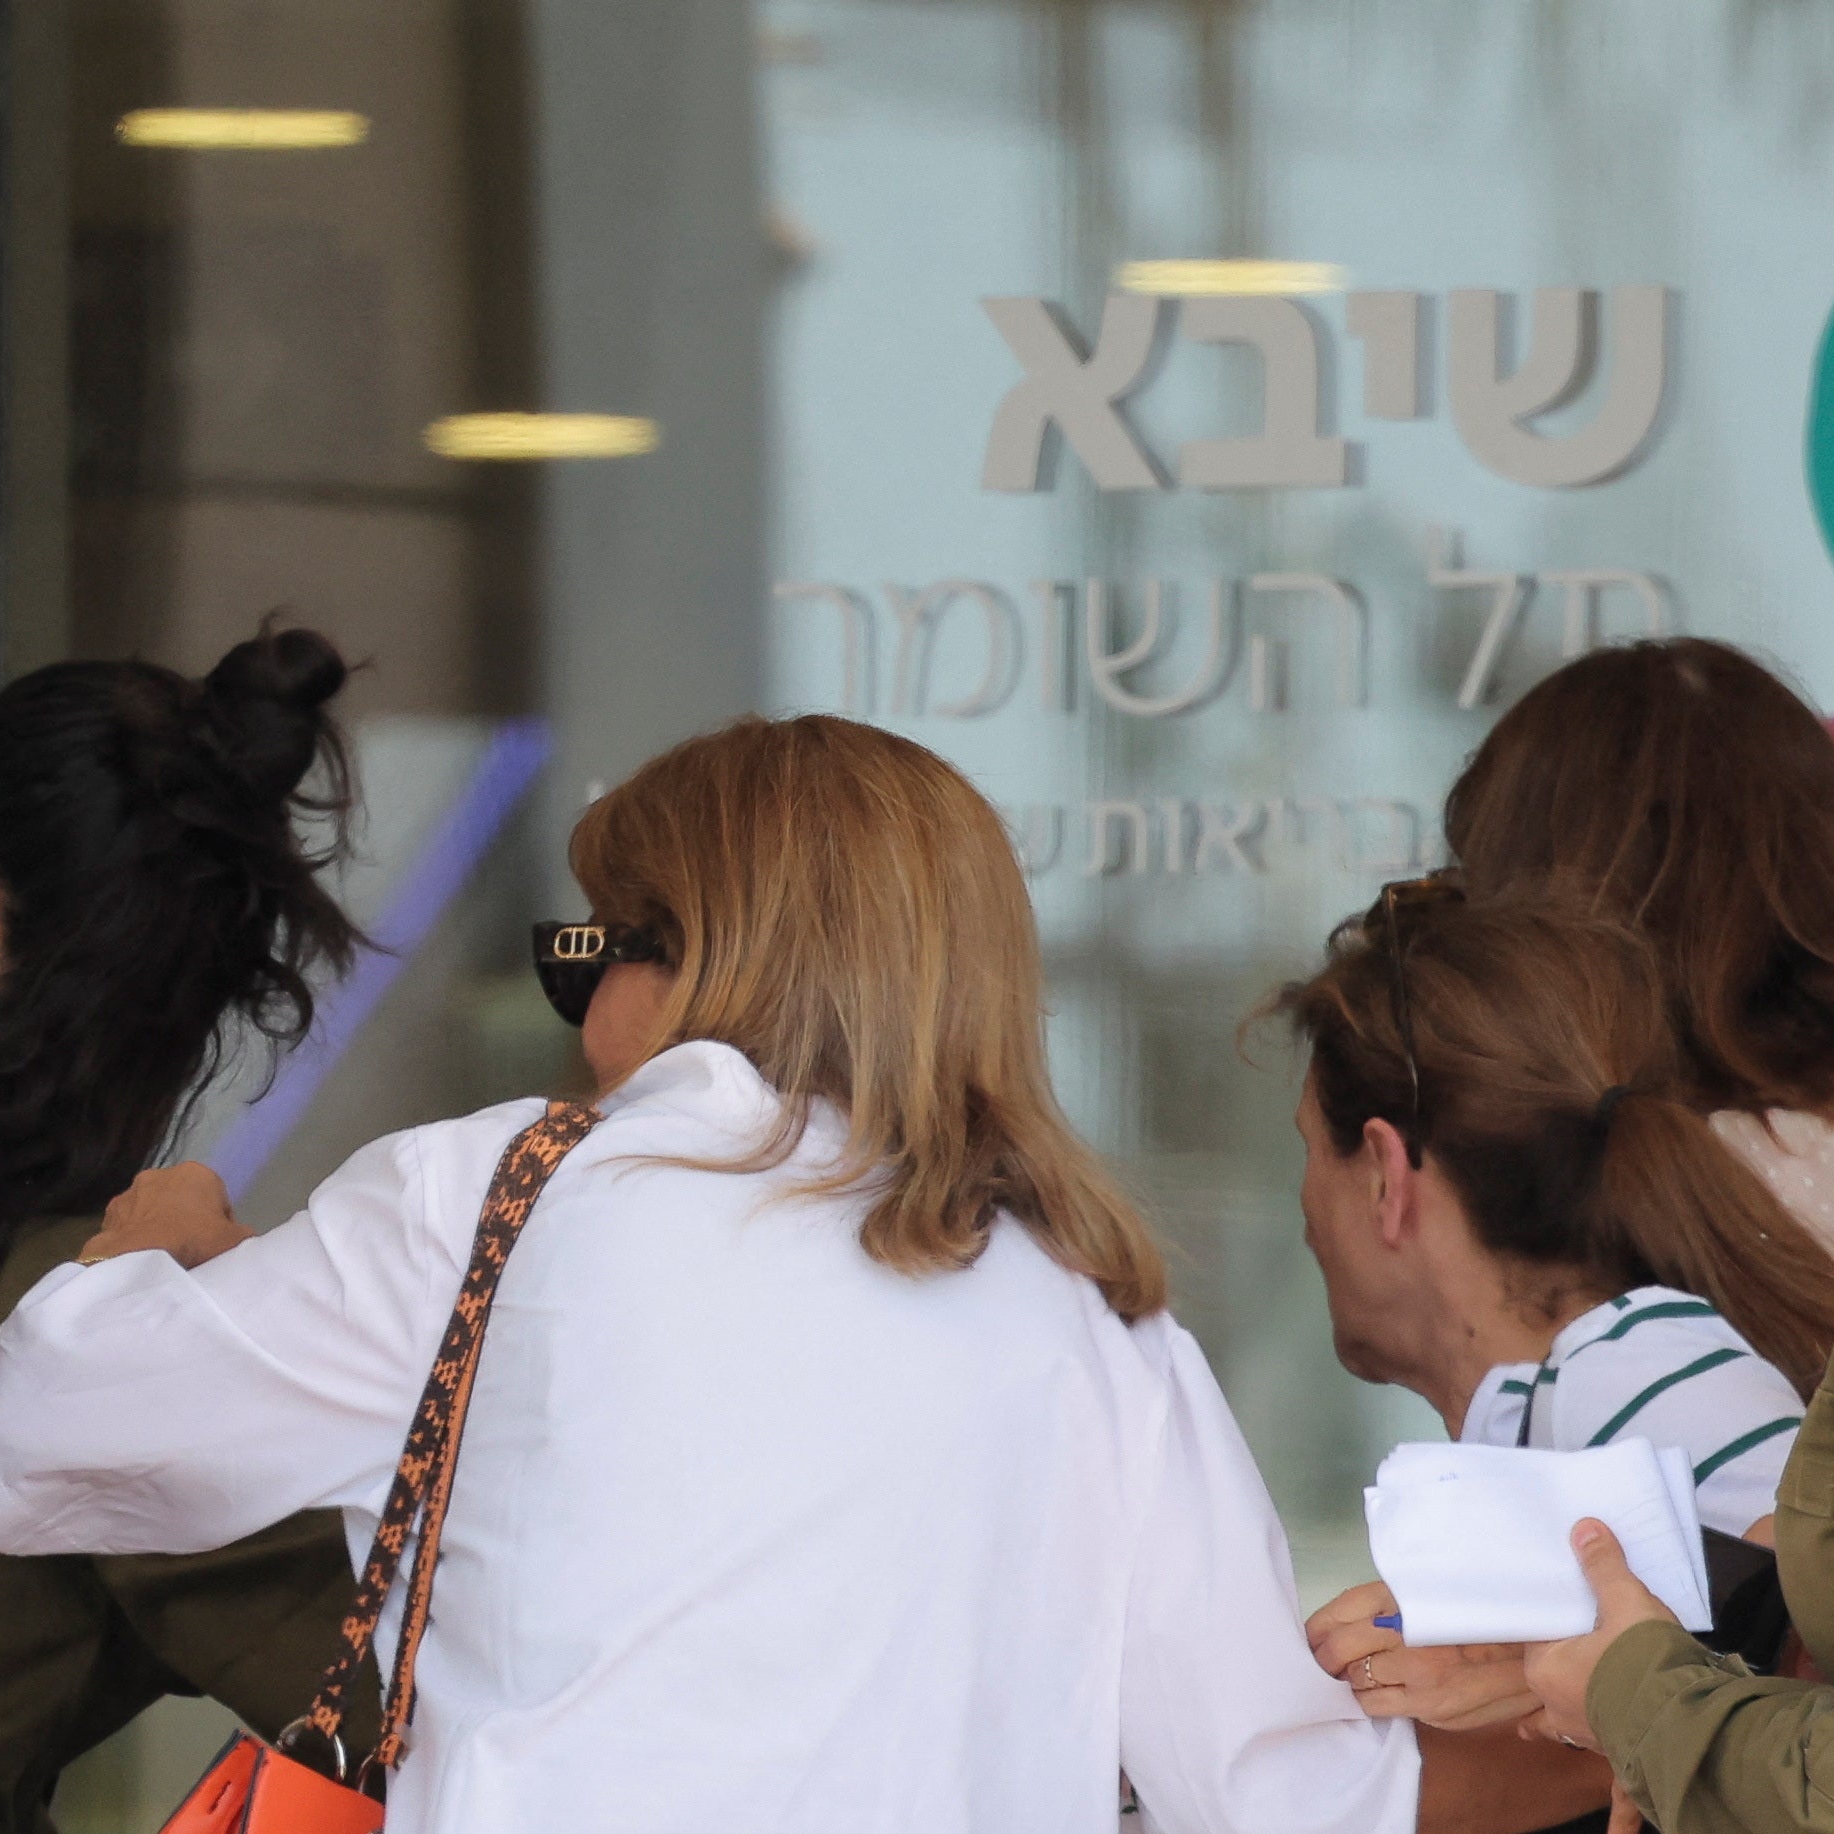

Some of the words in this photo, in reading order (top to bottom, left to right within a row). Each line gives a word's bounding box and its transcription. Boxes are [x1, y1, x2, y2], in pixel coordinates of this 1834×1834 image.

[979, 284, 1667, 490] שיבא
[771, 573, 1369, 717] השומר
[1085, 797, 1441, 878] בריאות
